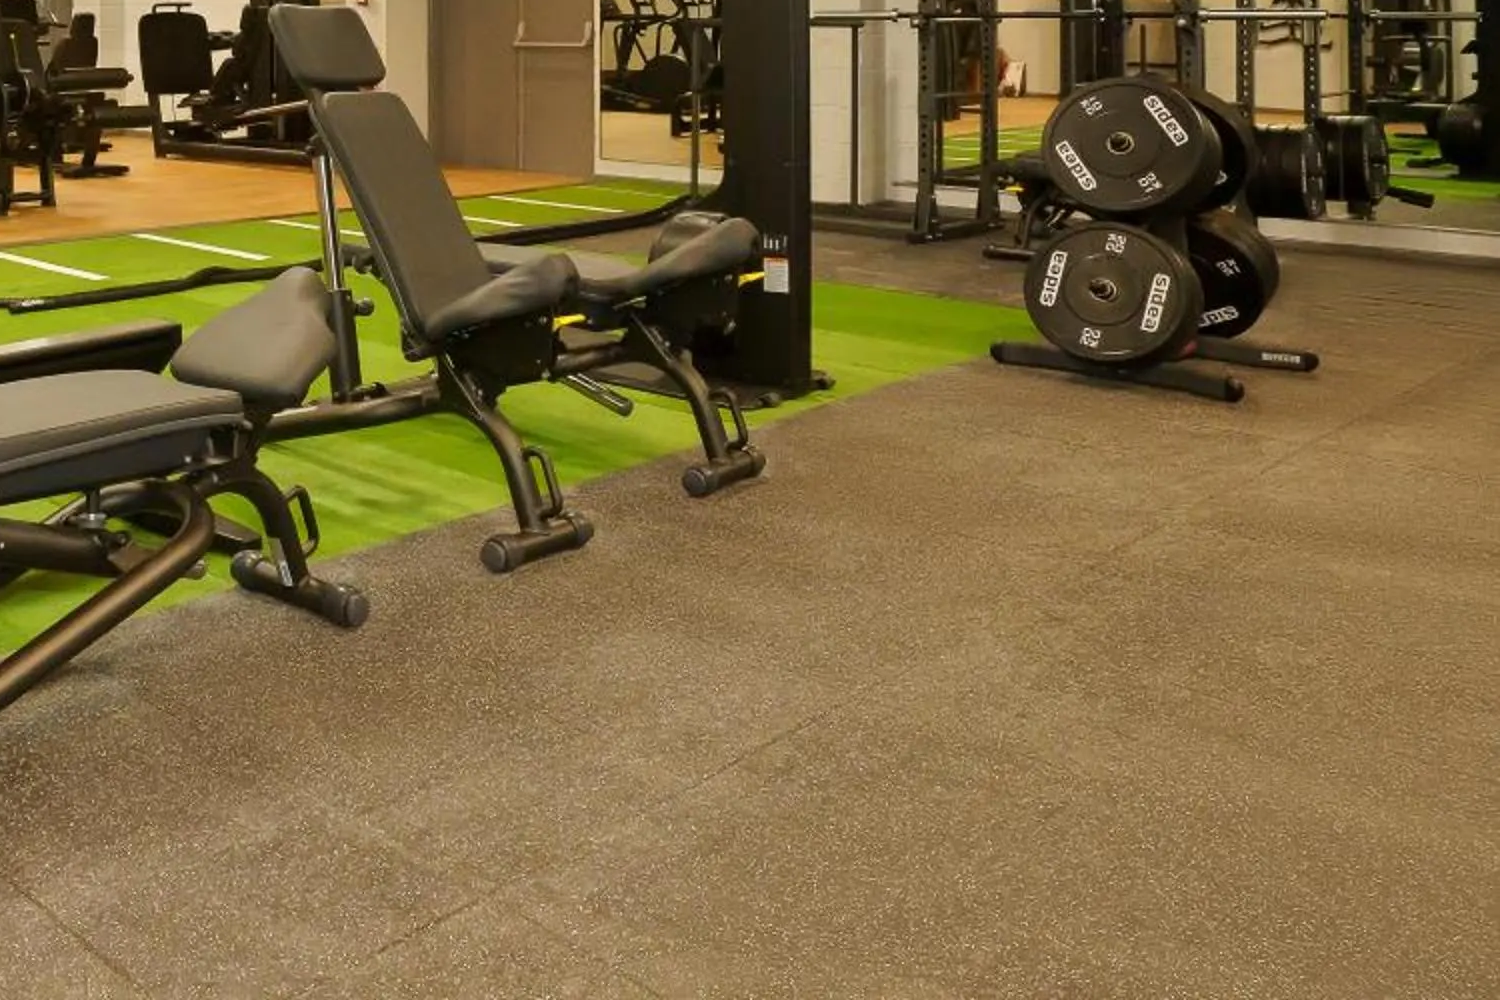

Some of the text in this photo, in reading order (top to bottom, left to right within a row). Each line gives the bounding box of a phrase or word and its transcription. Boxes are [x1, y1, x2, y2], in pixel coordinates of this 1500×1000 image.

[1144, 95, 1189, 146] sidea
[1056, 141, 1097, 190] sidea
[1040, 251, 1067, 306] sidea
[1140, 273, 1170, 332] sidea
